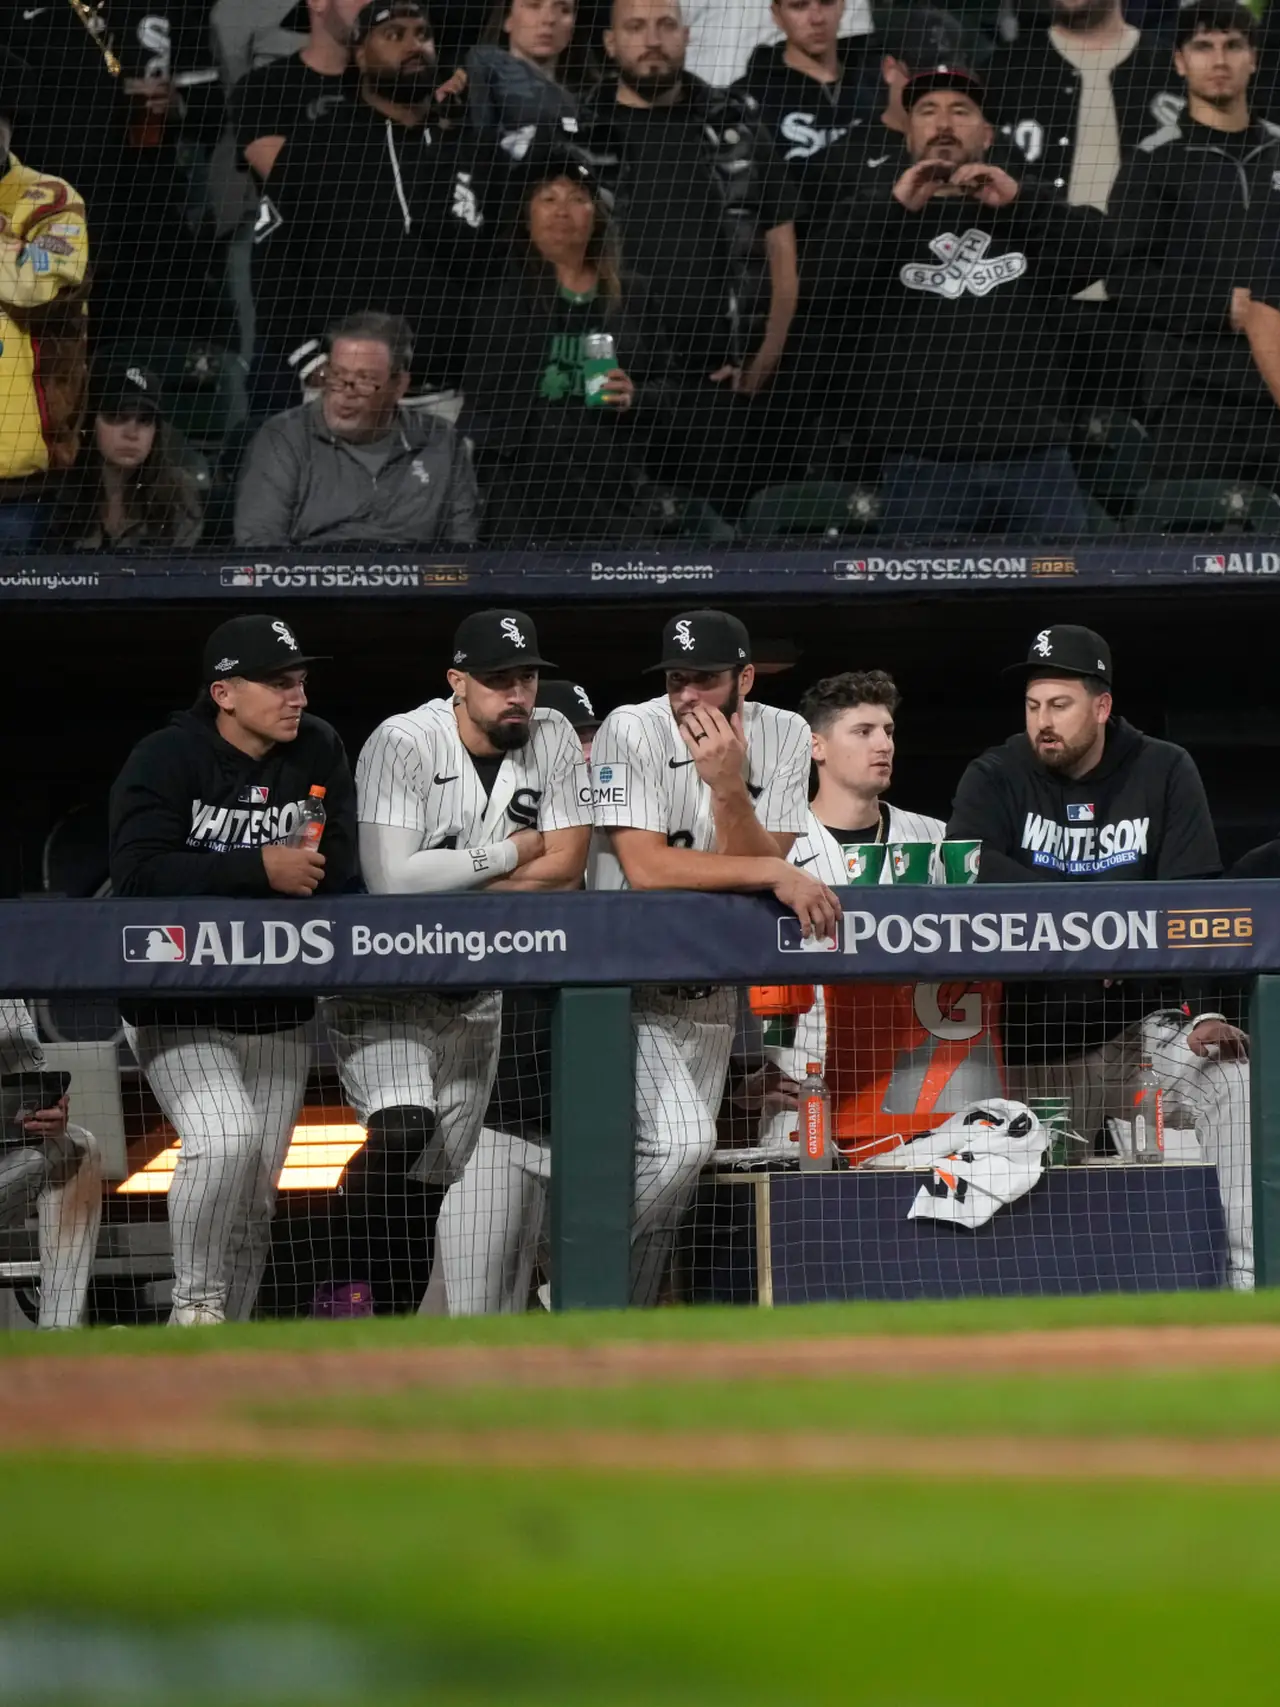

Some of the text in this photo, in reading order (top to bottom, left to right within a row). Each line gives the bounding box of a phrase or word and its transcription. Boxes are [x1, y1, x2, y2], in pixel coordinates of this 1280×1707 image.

[914, 237, 1013, 286] SOUTH SIDE
[0, 569, 99, 589] ooking.com
[254, 564, 419, 587] POSTSEASON
[591, 561, 713, 584] Booking.com
[867, 557, 1027, 581] POSTSEASON
[501, 618, 525, 648] Sox
[673, 620, 695, 651] Sox
[1033, 630, 1053, 657] Sox
[1021, 812, 1149, 861] WHITE SOX
[1034, 853, 1049, 864] NO
[1070, 861, 1092, 872] LIKE
[1092, 851, 1137, 871] OCTOBER
[190, 919, 567, 965] ALDS Booking.com
[842, 910, 1253, 954] POSTSEASON 2026
[807, 1101, 817, 1155] GATORADE
